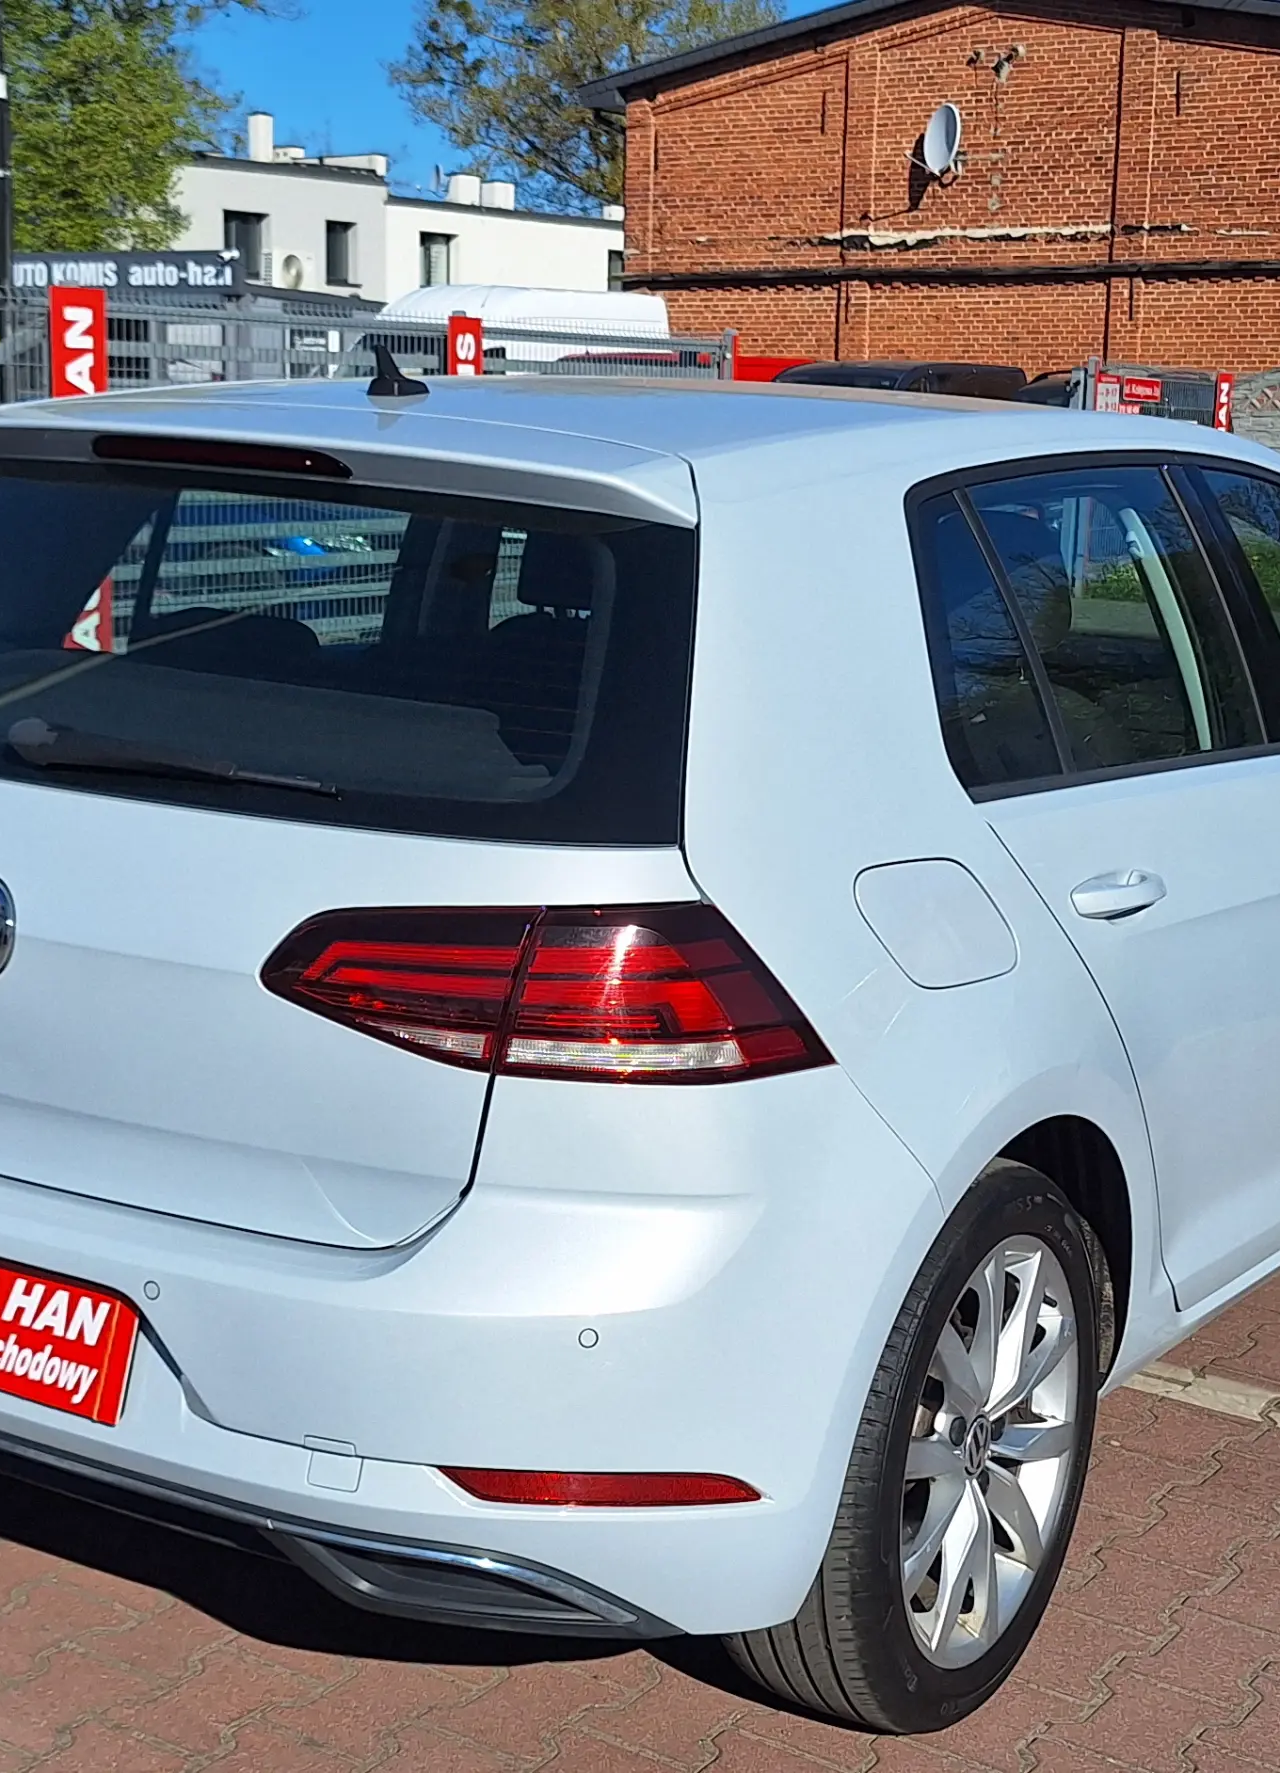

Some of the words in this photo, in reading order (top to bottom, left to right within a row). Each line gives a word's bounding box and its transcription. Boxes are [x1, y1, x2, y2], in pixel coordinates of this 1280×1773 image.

[13, 261, 48, 287] UTO
[50, 260, 119, 287] KOMIS
[62, 305, 95, 396] AN
[1218, 382, 1230, 432] AN
[1, 1277, 111, 1347] HAN
